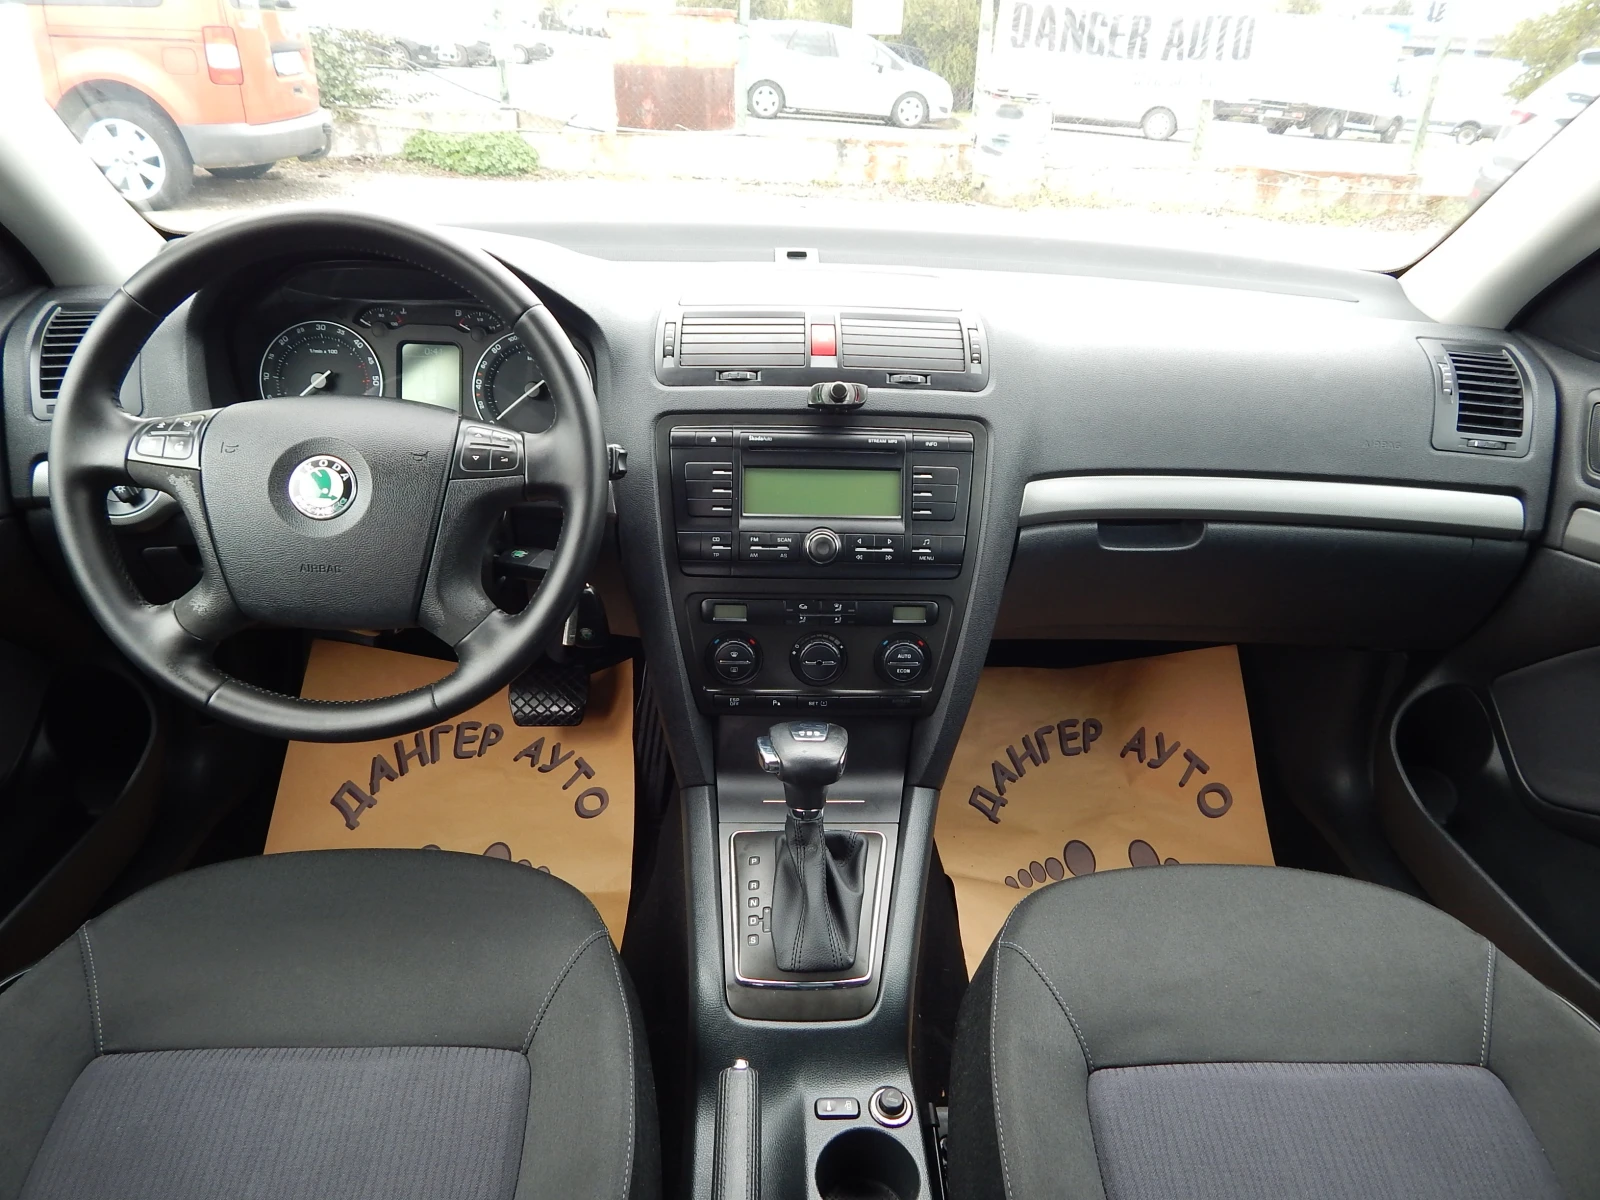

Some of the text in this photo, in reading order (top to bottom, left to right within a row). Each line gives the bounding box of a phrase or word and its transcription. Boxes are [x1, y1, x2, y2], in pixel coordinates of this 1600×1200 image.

[1010, 2, 1256, 61] DANGER AUTO
[336, 328, 346, 336] 35
[278, 335, 289, 346] 20
[353, 339, 364, 348] 40
[491, 343, 502, 354] 80
[263, 372, 270, 381] 10
[372, 375, 380, 386] 50
[475, 379, 482, 390] 40
[300, 563, 342, 573] AIRBAG
[329, 720, 610, 831] ДАНГЕР АУТО
[968, 717, 1234, 825] ДАНГЕР АУТО
